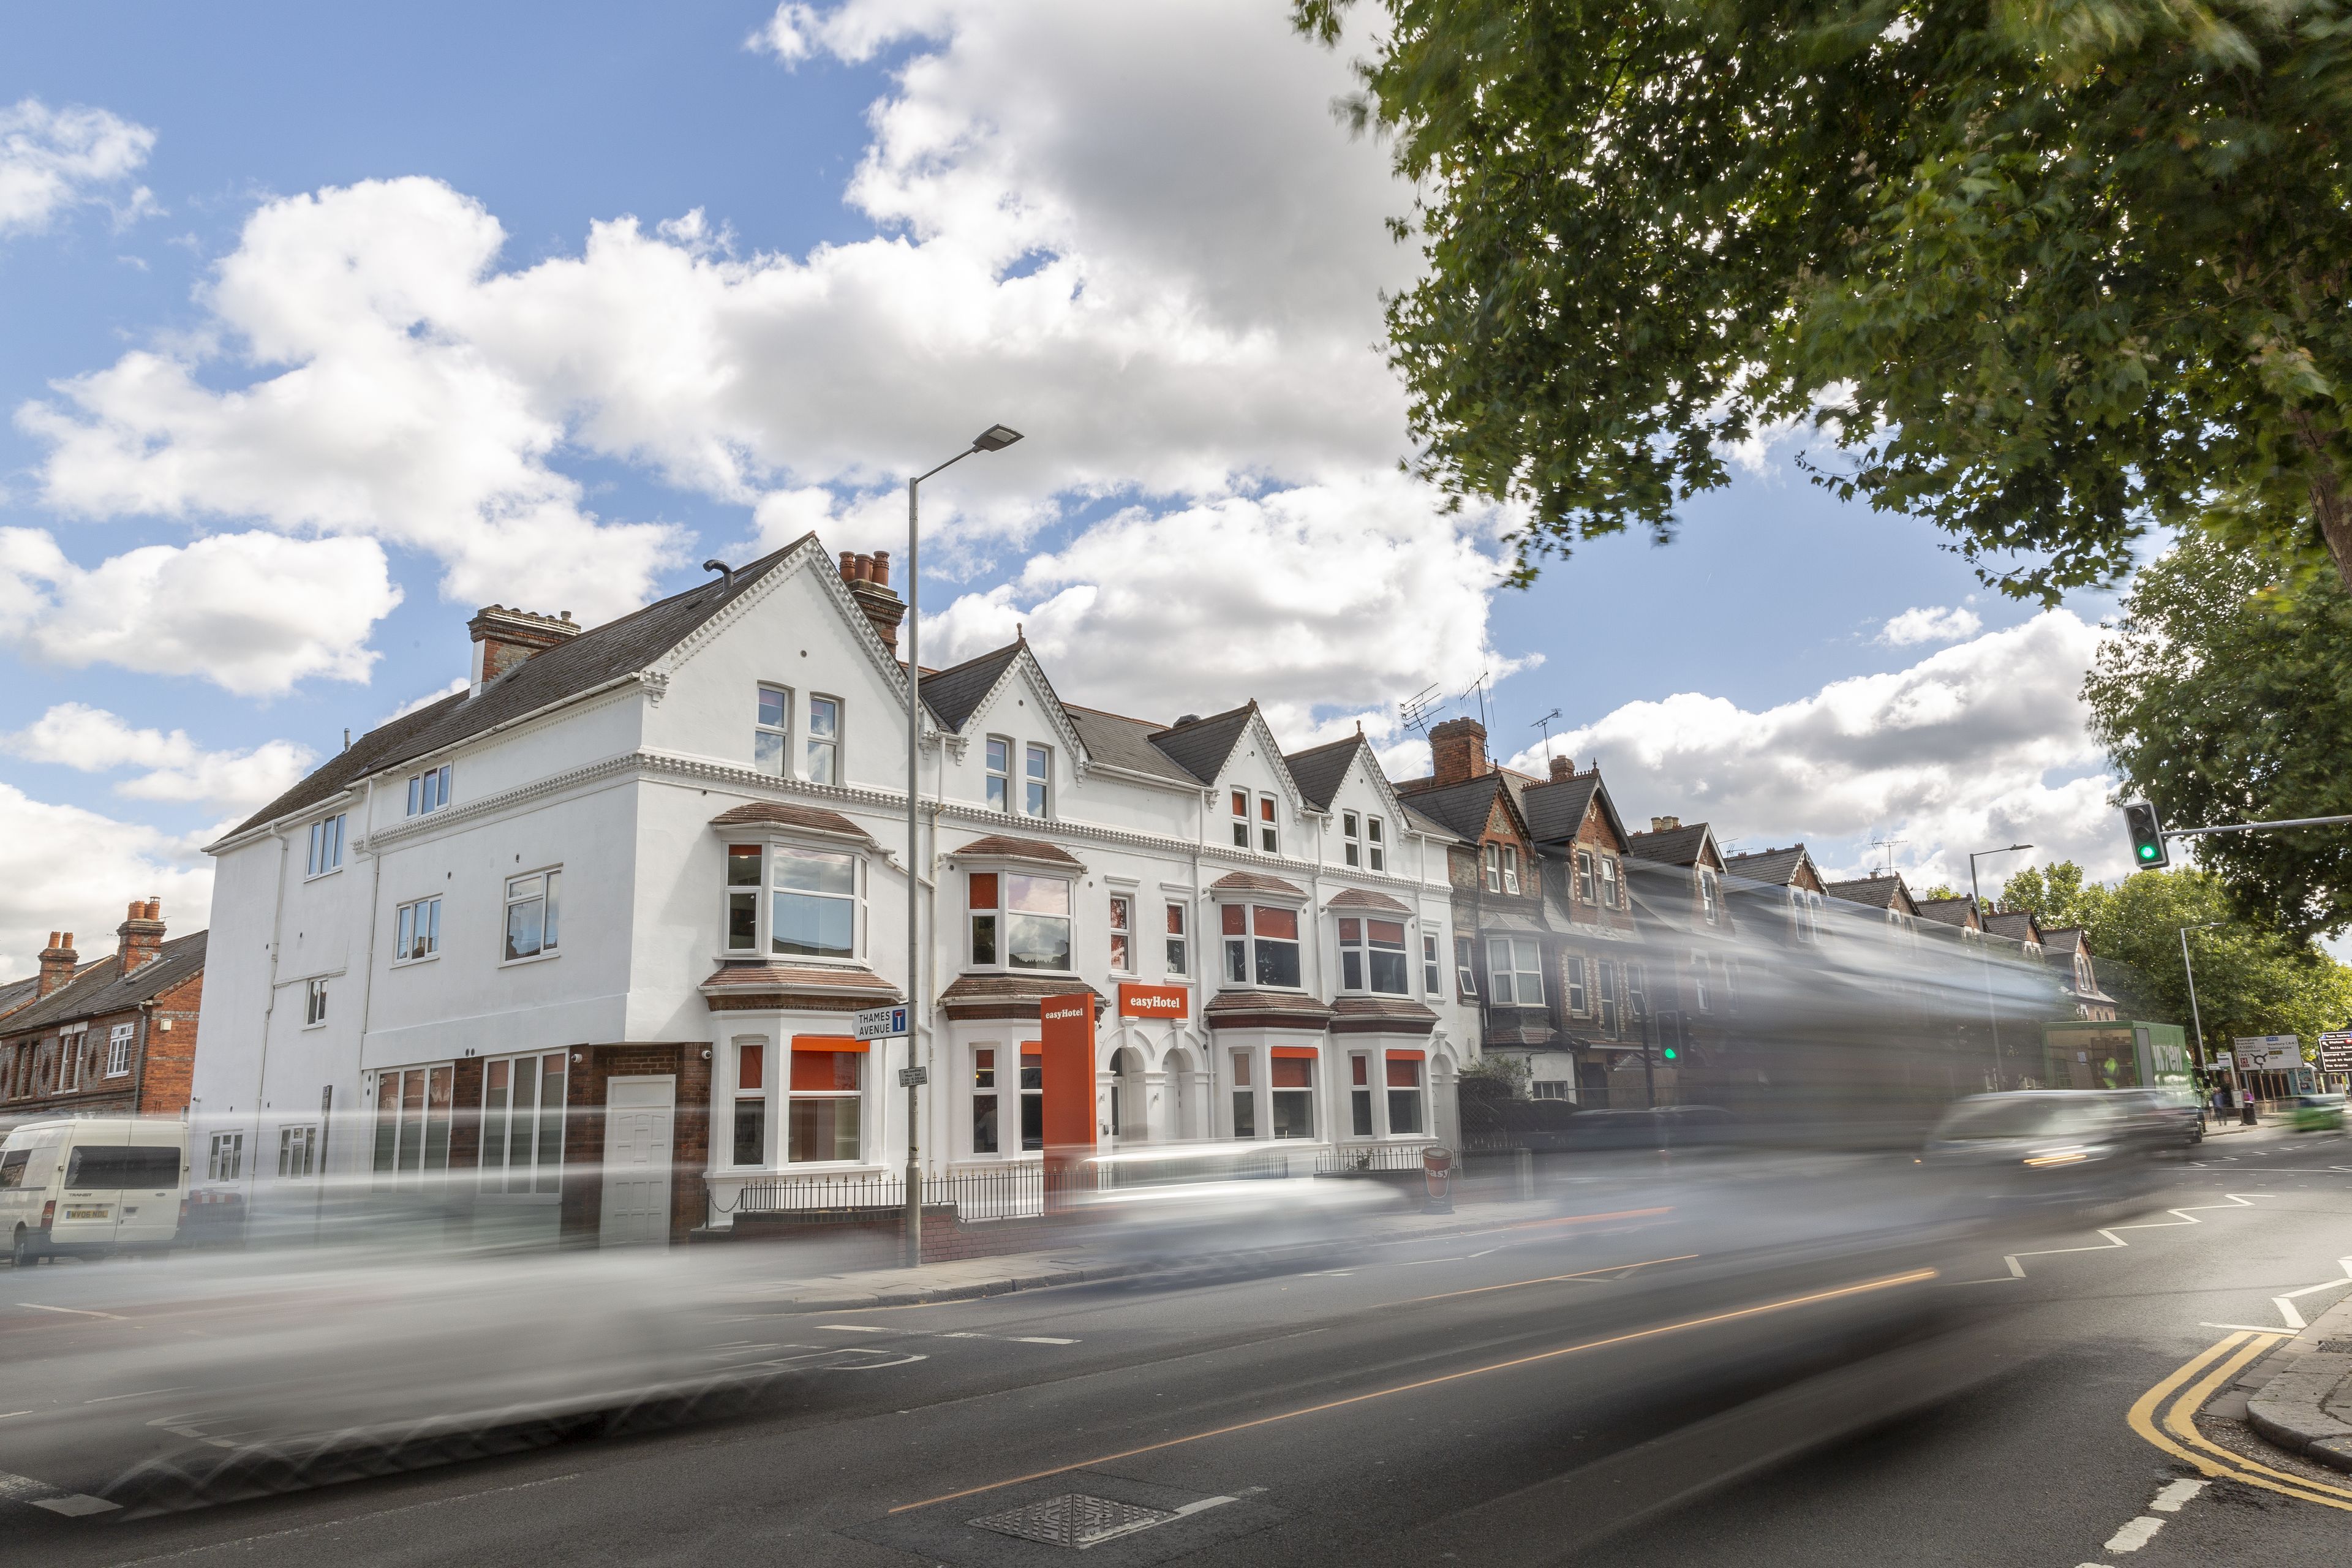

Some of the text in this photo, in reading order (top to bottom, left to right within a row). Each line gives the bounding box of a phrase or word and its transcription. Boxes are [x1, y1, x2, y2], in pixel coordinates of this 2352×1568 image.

[1130, 996, 1180, 1009] easyHotel
[859, 1011, 890, 1023] THAMES
[1046, 1008, 1083, 1020] easyHotel
[859, 1023, 890, 1036] AVENUE
[1425, 1167, 1450, 1178] easy
